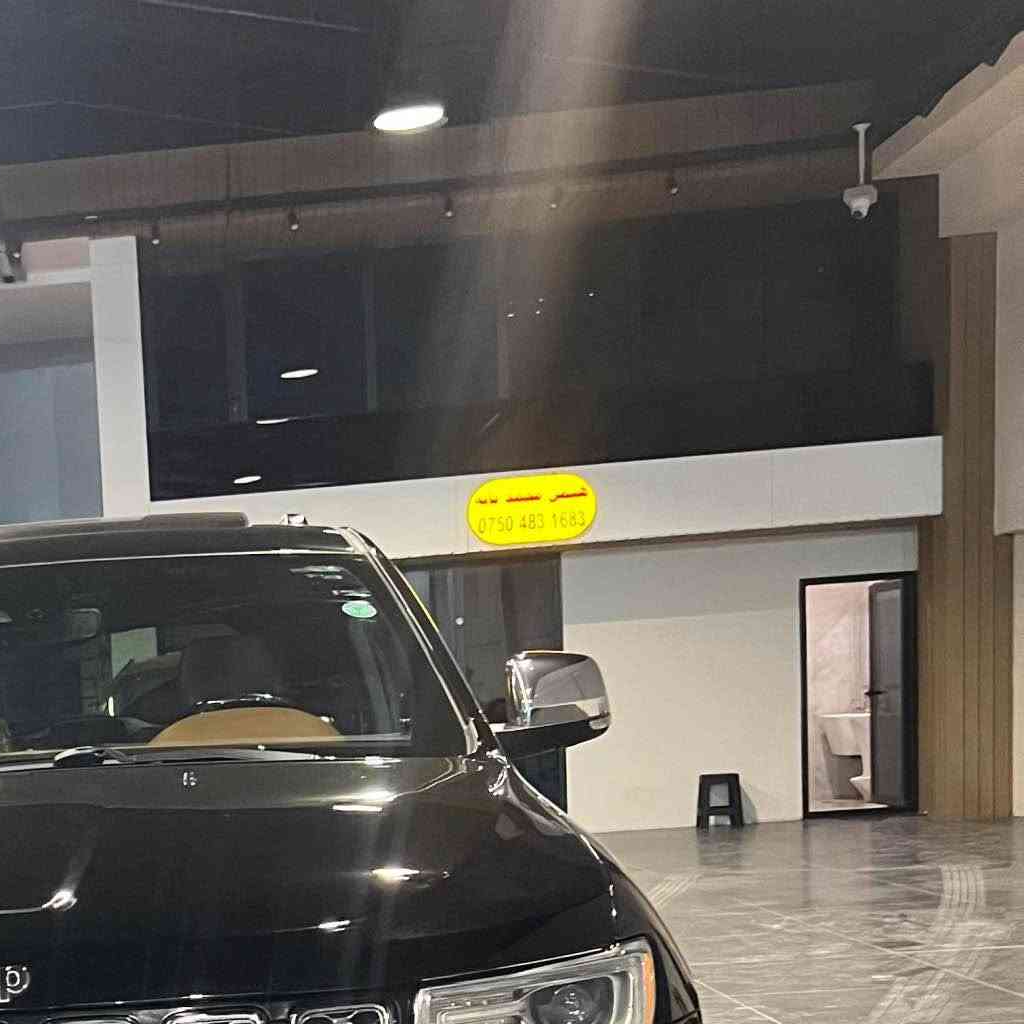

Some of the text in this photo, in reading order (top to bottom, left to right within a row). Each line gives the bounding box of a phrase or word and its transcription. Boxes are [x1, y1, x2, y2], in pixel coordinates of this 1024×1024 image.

[478, 511, 586, 534] 0750 483 1683
